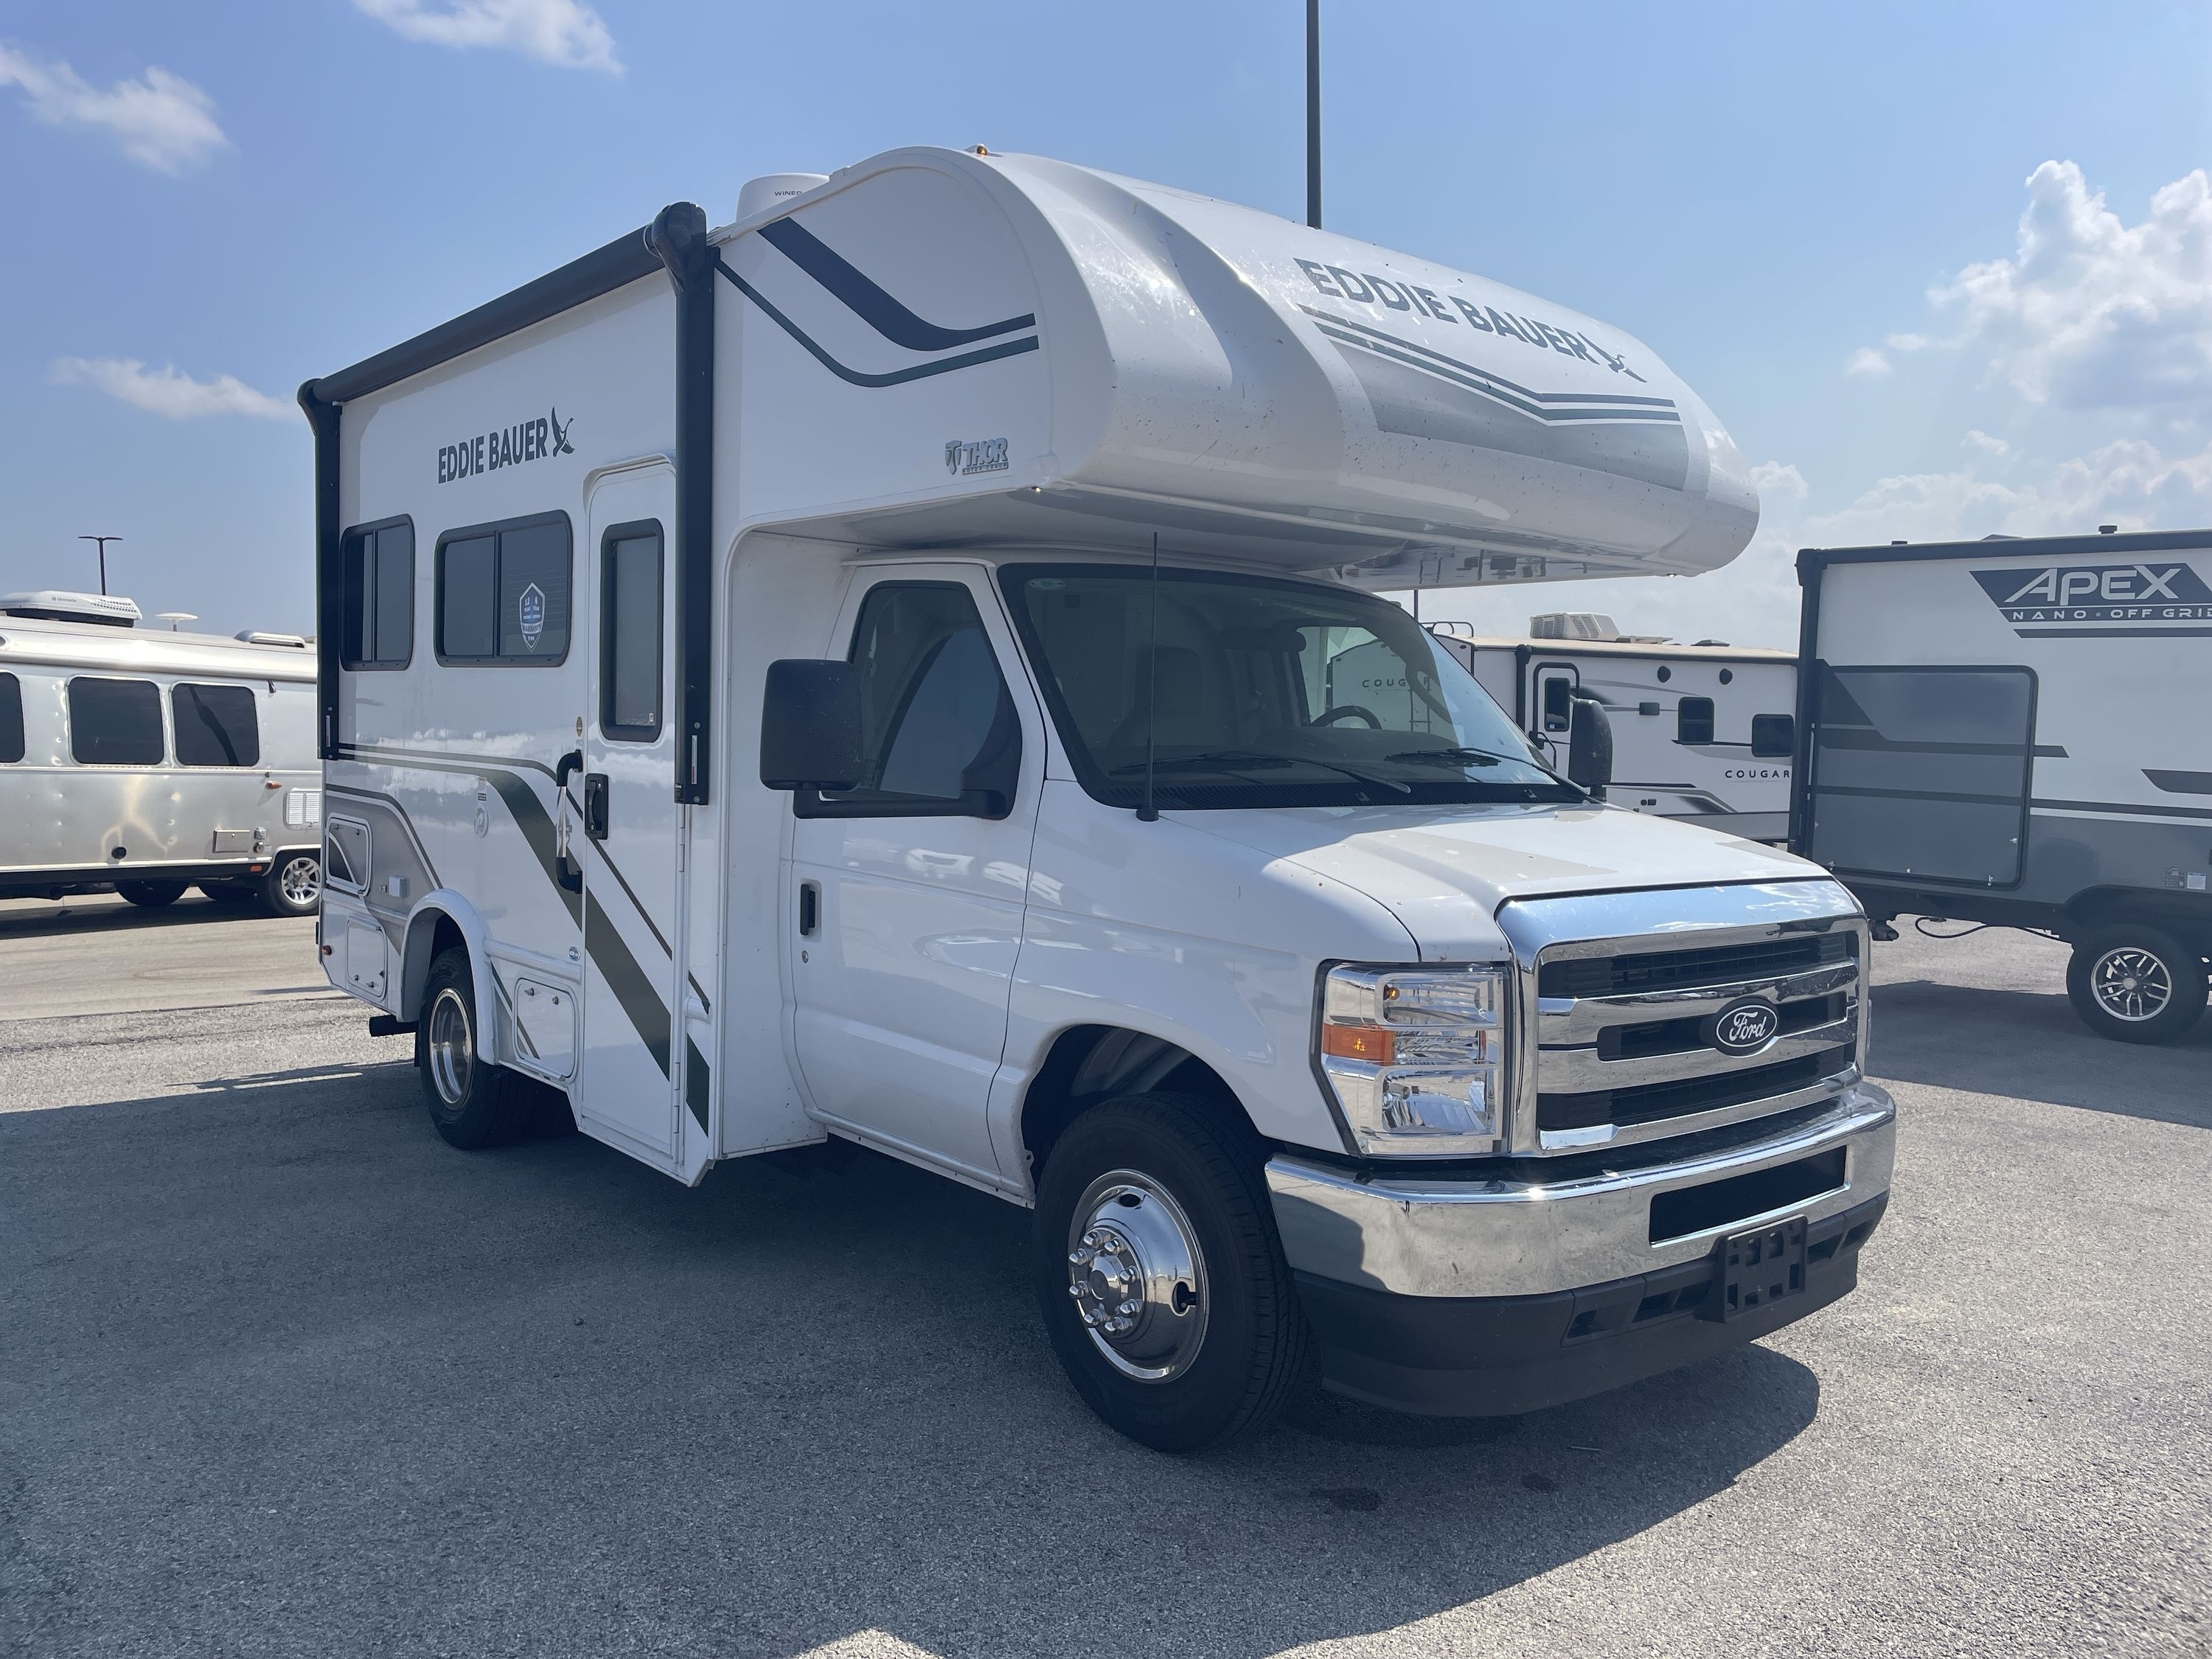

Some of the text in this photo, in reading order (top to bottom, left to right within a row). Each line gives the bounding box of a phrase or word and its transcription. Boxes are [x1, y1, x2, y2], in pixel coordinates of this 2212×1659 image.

[1292, 257, 1601, 366] EDDIE BAUER
[438, 417, 548, 484] EDDIE BAUER
[962, 437, 1009, 467] THOR
[2003, 565, 2183, 606] APEX
[2012, 610, 2087, 621] NANO
[2110, 608, 2152, 619] OFF
[1362, 677, 1431, 688] COUGR
[1725, 770, 1790, 778] COUGAR
[1728, 1011, 1767, 1042] Ford
